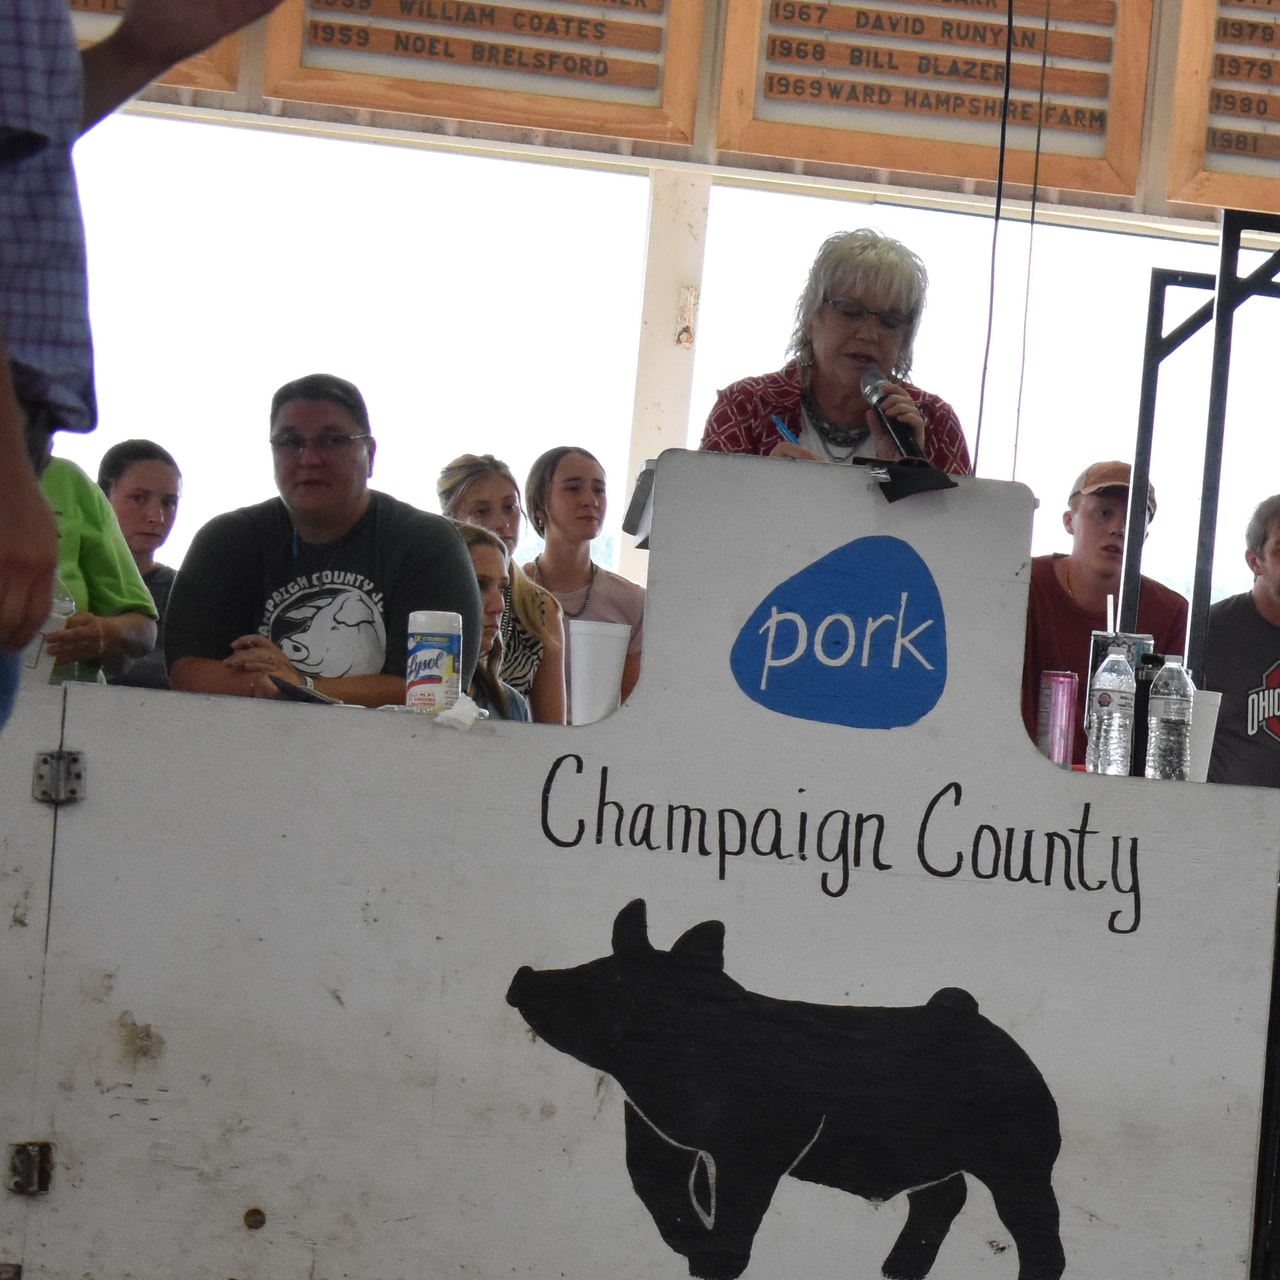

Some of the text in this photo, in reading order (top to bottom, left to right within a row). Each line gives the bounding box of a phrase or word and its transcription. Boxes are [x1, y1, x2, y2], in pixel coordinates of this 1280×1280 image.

[397, 0, 607, 40] WILLIAM COATES
[772, 3, 1036, 49] 1967 DAVID RUNYAN
[1220, 20, 1275, 43] 1978
[312, 24, 609, 77] 1959 NOEL BRELSFORD
[769, 38, 1005, 83] 1968 BILL BLAZER
[1218, 57, 1273, 79] 1979
[767, 76, 1105, 130] 1969 WARD HAMPSHIRE FARM
[1215, 93, 1268, 116] 1980
[1209, 131, 1258, 153] 1981
[312, 570, 374, 591] COUNTY
[759, 591, 935, 690] pork
[407, 652, 443, 679] Lysol
[541, 752, 1142, 934] Champaign County
